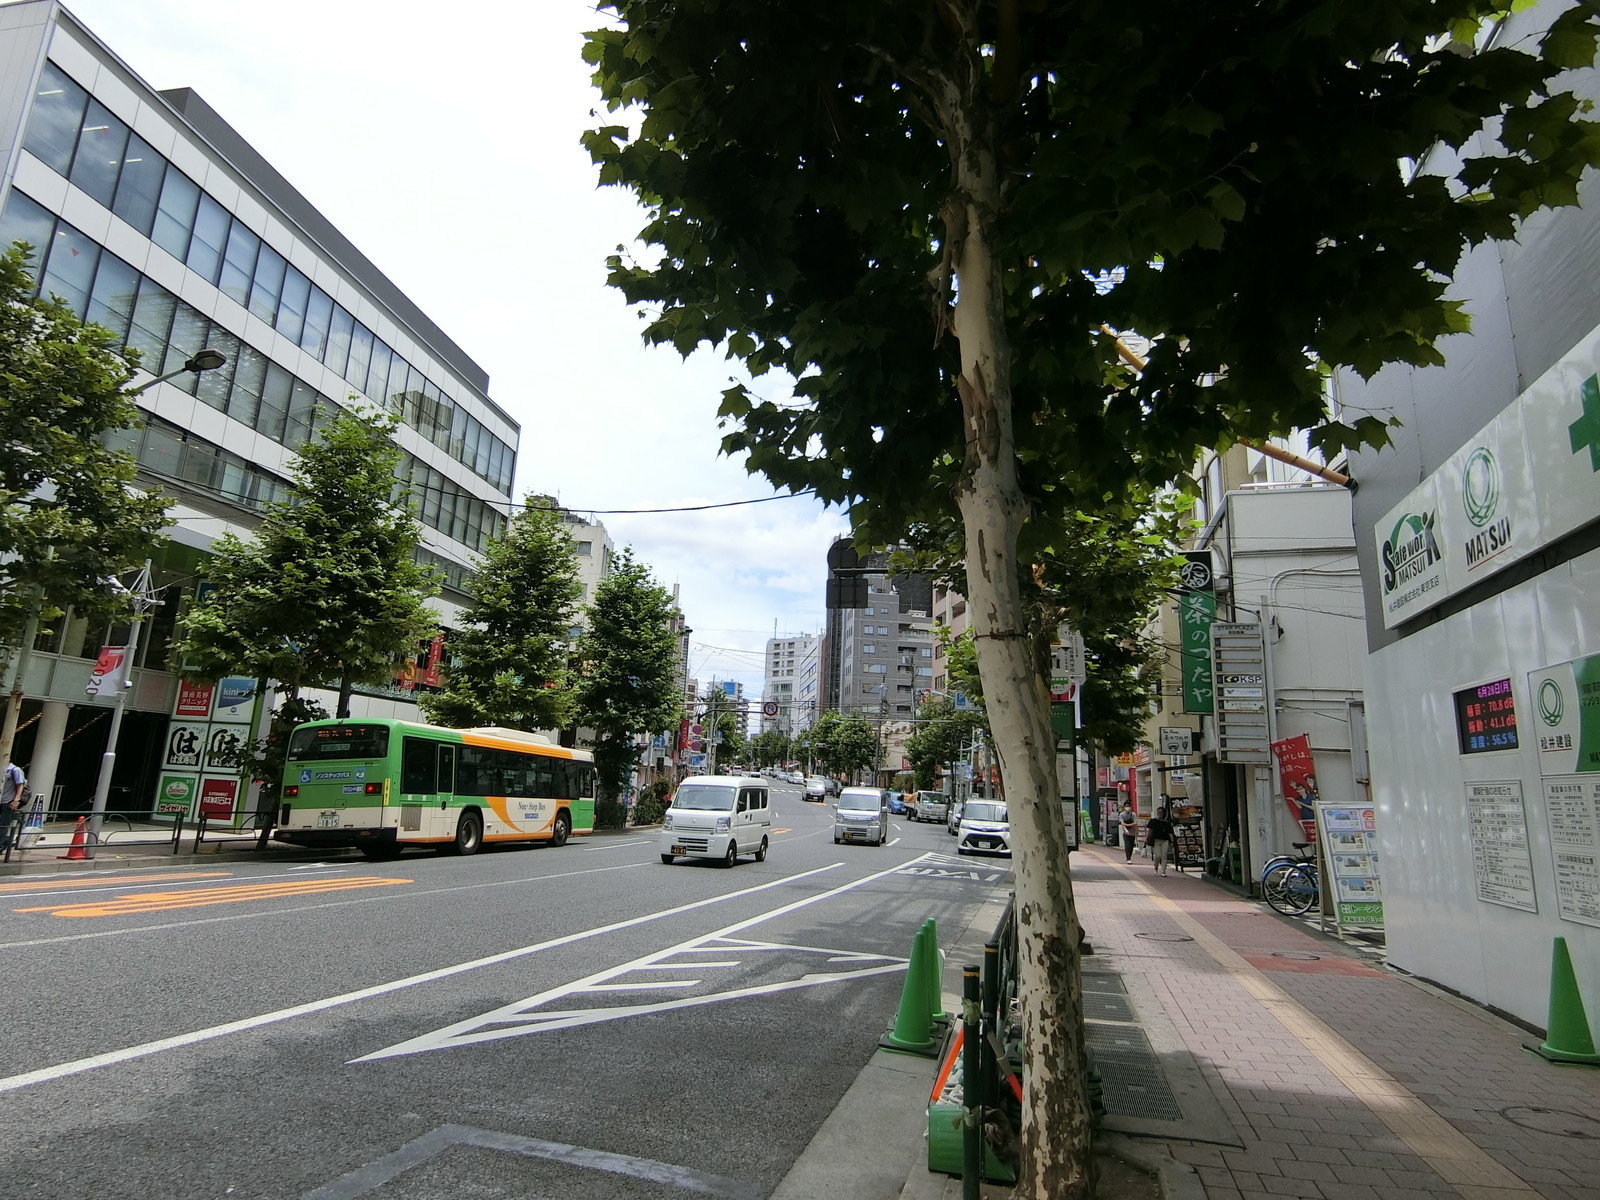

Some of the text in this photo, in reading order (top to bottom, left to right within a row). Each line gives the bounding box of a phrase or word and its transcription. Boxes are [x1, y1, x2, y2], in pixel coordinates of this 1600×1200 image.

[1465, 516, 1512, 567] MATSUI
[1398, 555, 1427, 586] MATSUI
[1185, 596, 1213, 704] 茶のつたや
[1240, 675, 1262, 683] KSP
[181, 698, 208, 706] クリニック
[1541, 734, 1573, 750] 松井建設
[315, 772, 351, 780] ノンステップバス
